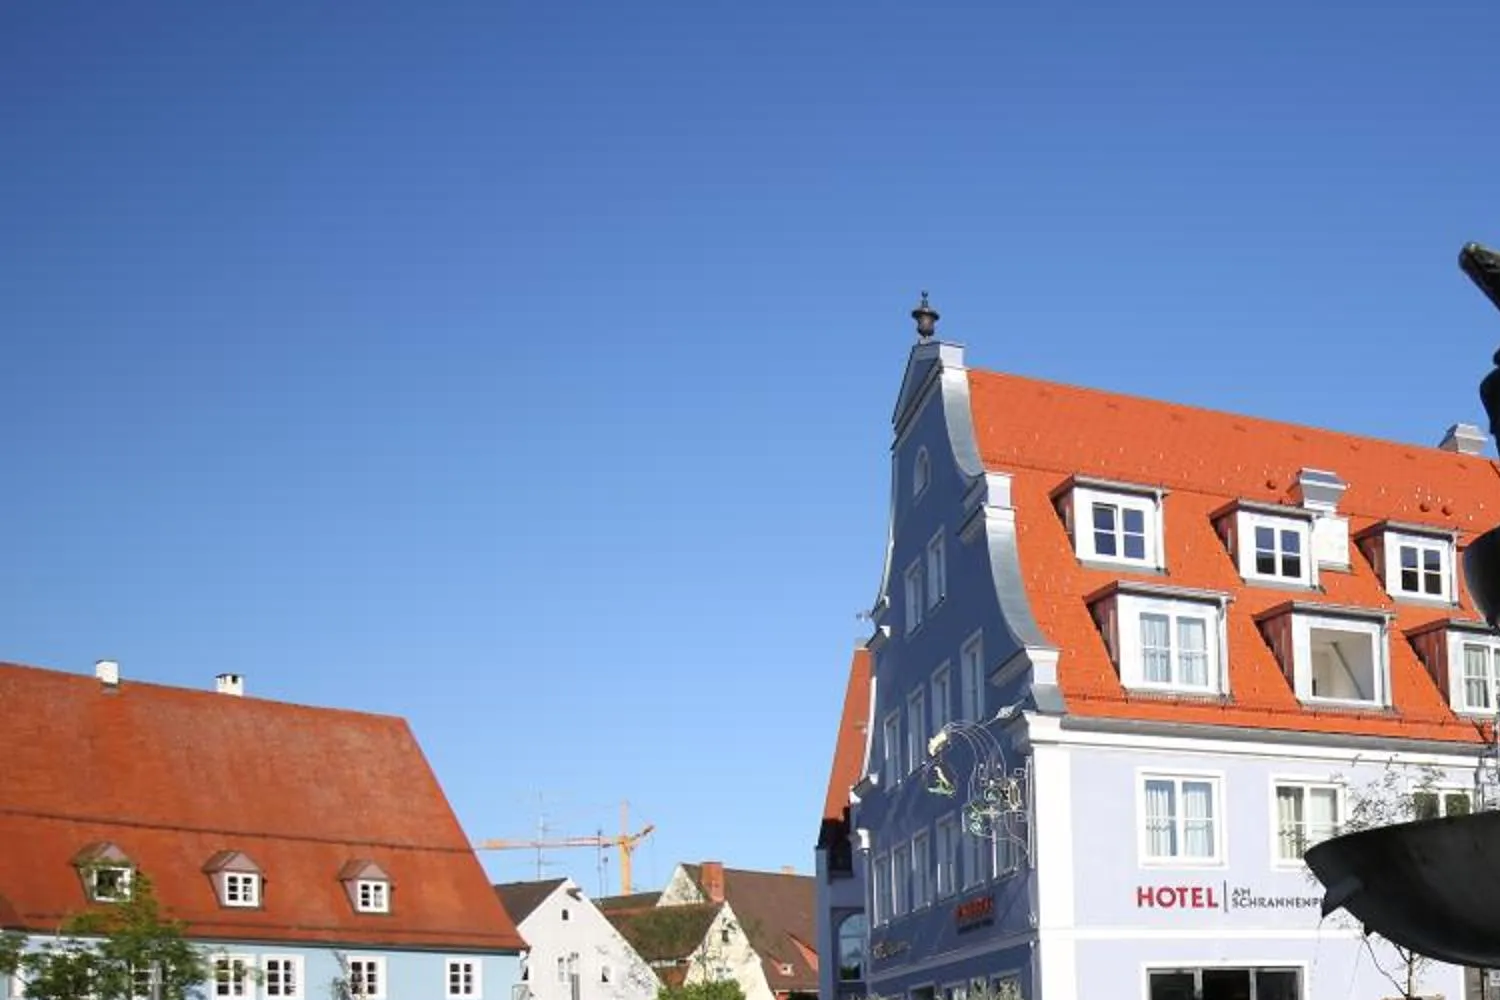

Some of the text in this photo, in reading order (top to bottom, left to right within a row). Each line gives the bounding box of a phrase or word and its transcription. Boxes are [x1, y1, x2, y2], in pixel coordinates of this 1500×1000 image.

[1137, 886, 1218, 909] HOTEL
[1232, 887, 1251, 897] AM
[1232, 897, 1324, 909] SCHRANNENP
